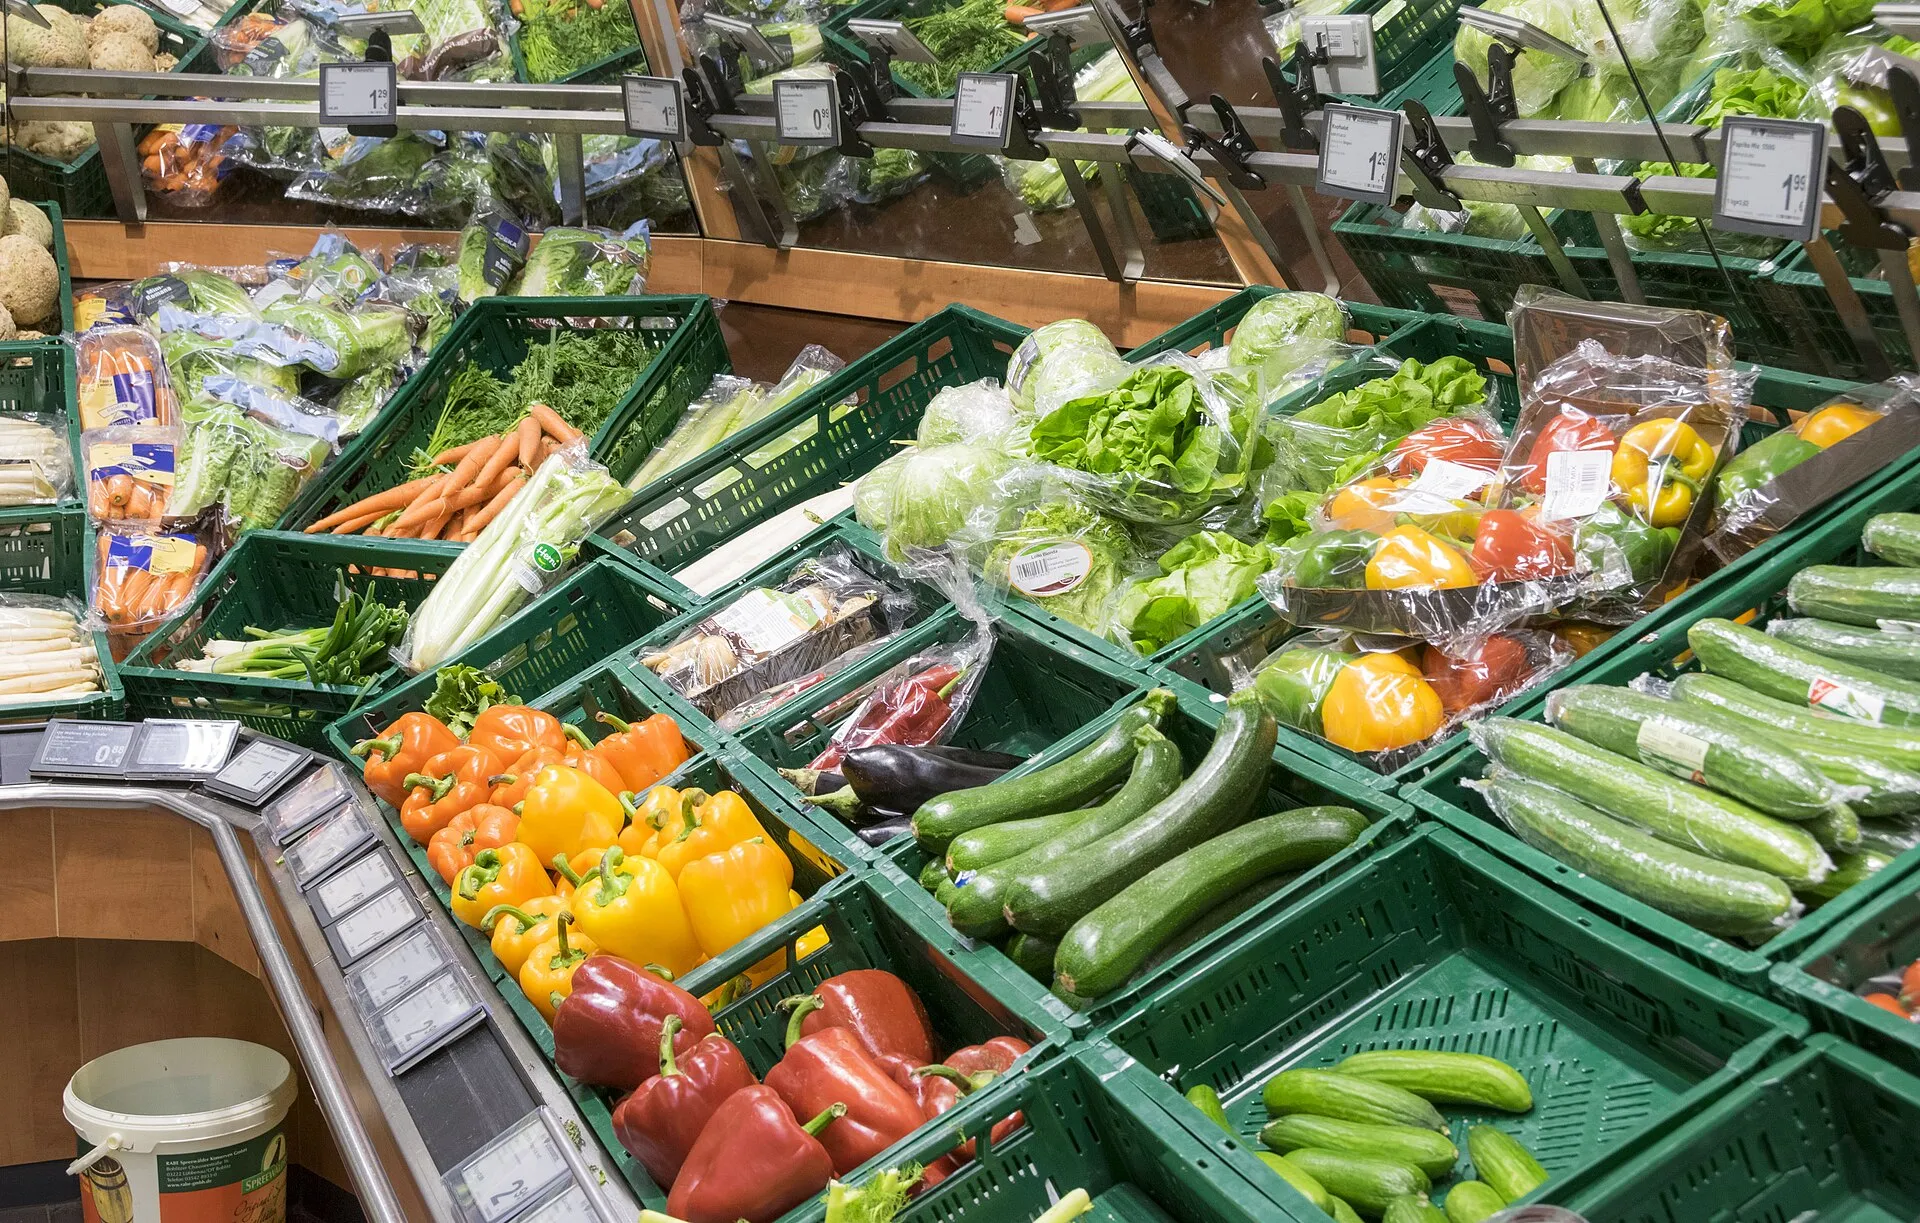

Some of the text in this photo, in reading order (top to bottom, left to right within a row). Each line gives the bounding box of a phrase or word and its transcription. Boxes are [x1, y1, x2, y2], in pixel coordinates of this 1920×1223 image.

[495, 232, 517, 248] EDEKA
[145, 286, 172, 300] Romana
[233, 1147, 248, 1156] GmbH
